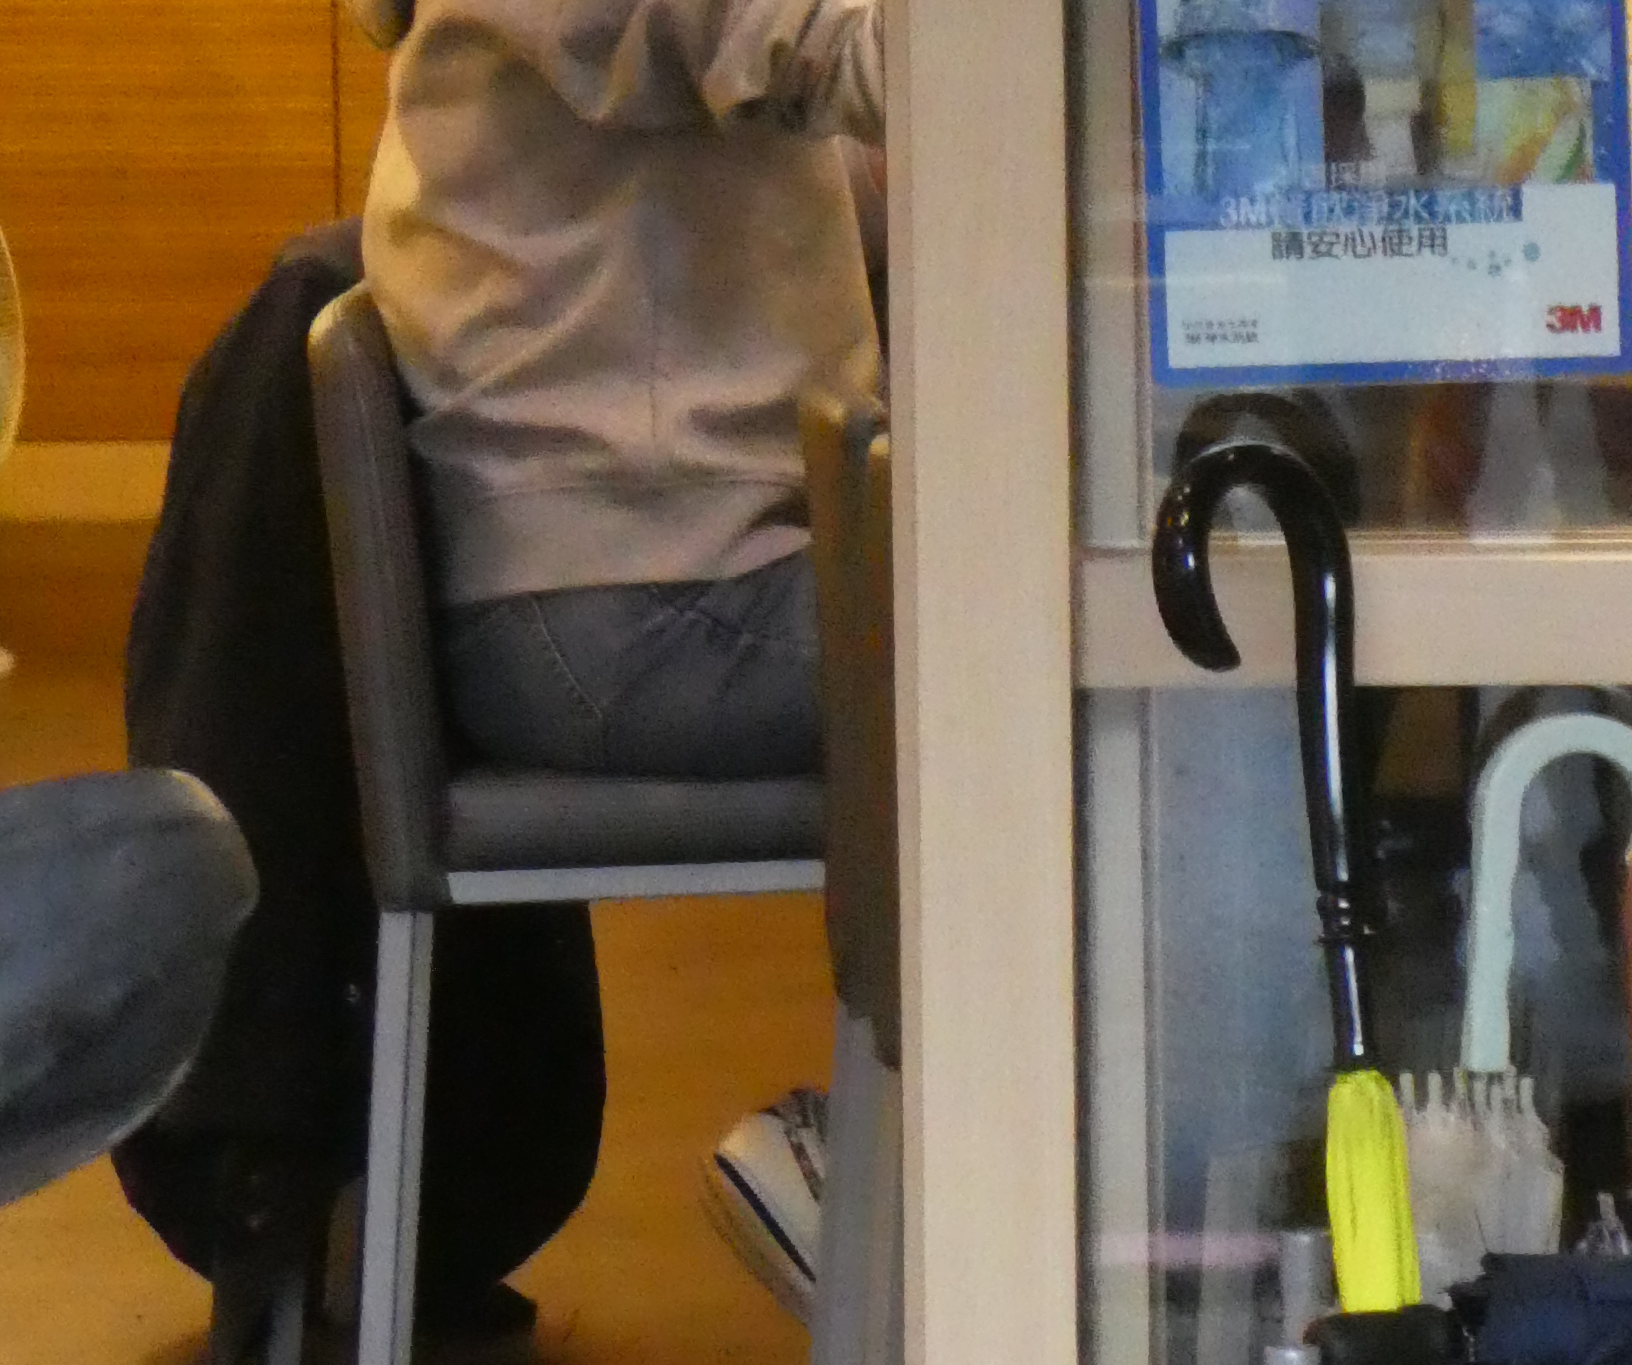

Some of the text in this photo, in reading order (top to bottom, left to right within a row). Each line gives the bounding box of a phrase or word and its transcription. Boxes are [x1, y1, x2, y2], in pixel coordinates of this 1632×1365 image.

[1270, 224, 1450, 261] 請安心使用
[1545, 303, 1602, 334] 3M
